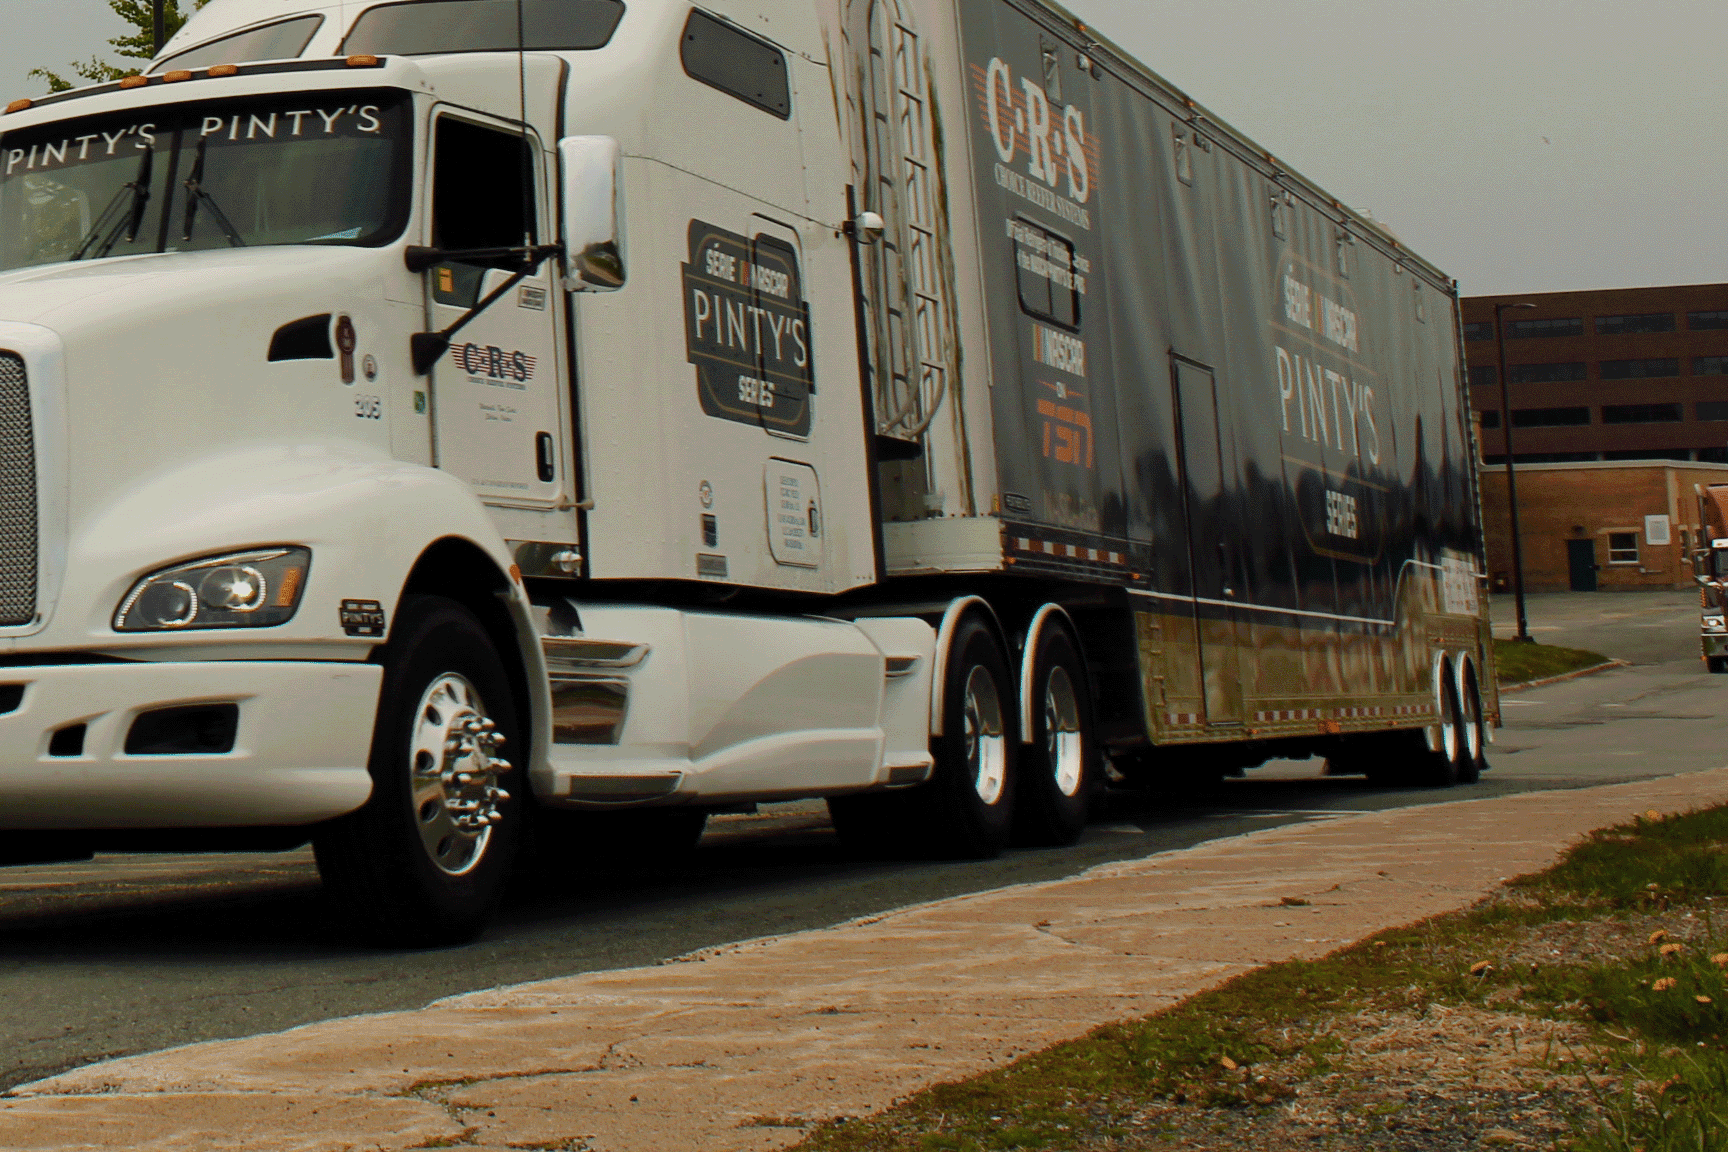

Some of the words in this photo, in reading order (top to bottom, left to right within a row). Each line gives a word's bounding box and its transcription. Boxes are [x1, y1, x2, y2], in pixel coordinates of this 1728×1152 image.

[201, 104, 380, 140] PINTY'S
[6, 123, 156, 175] PINTY'S
[705, 242, 736, 282] SÉRIE
[750, 263, 789, 299] NASCAR
[693, 288, 807, 368] PINTY'S
[1042, 328, 1087, 377] NASCAR
[738, 374, 774, 408] SERIES
[1275, 345, 1381, 466] PINTY'S
[1326, 489, 1359, 540] SERIES
[342, 611, 384, 625] PINTY'S
